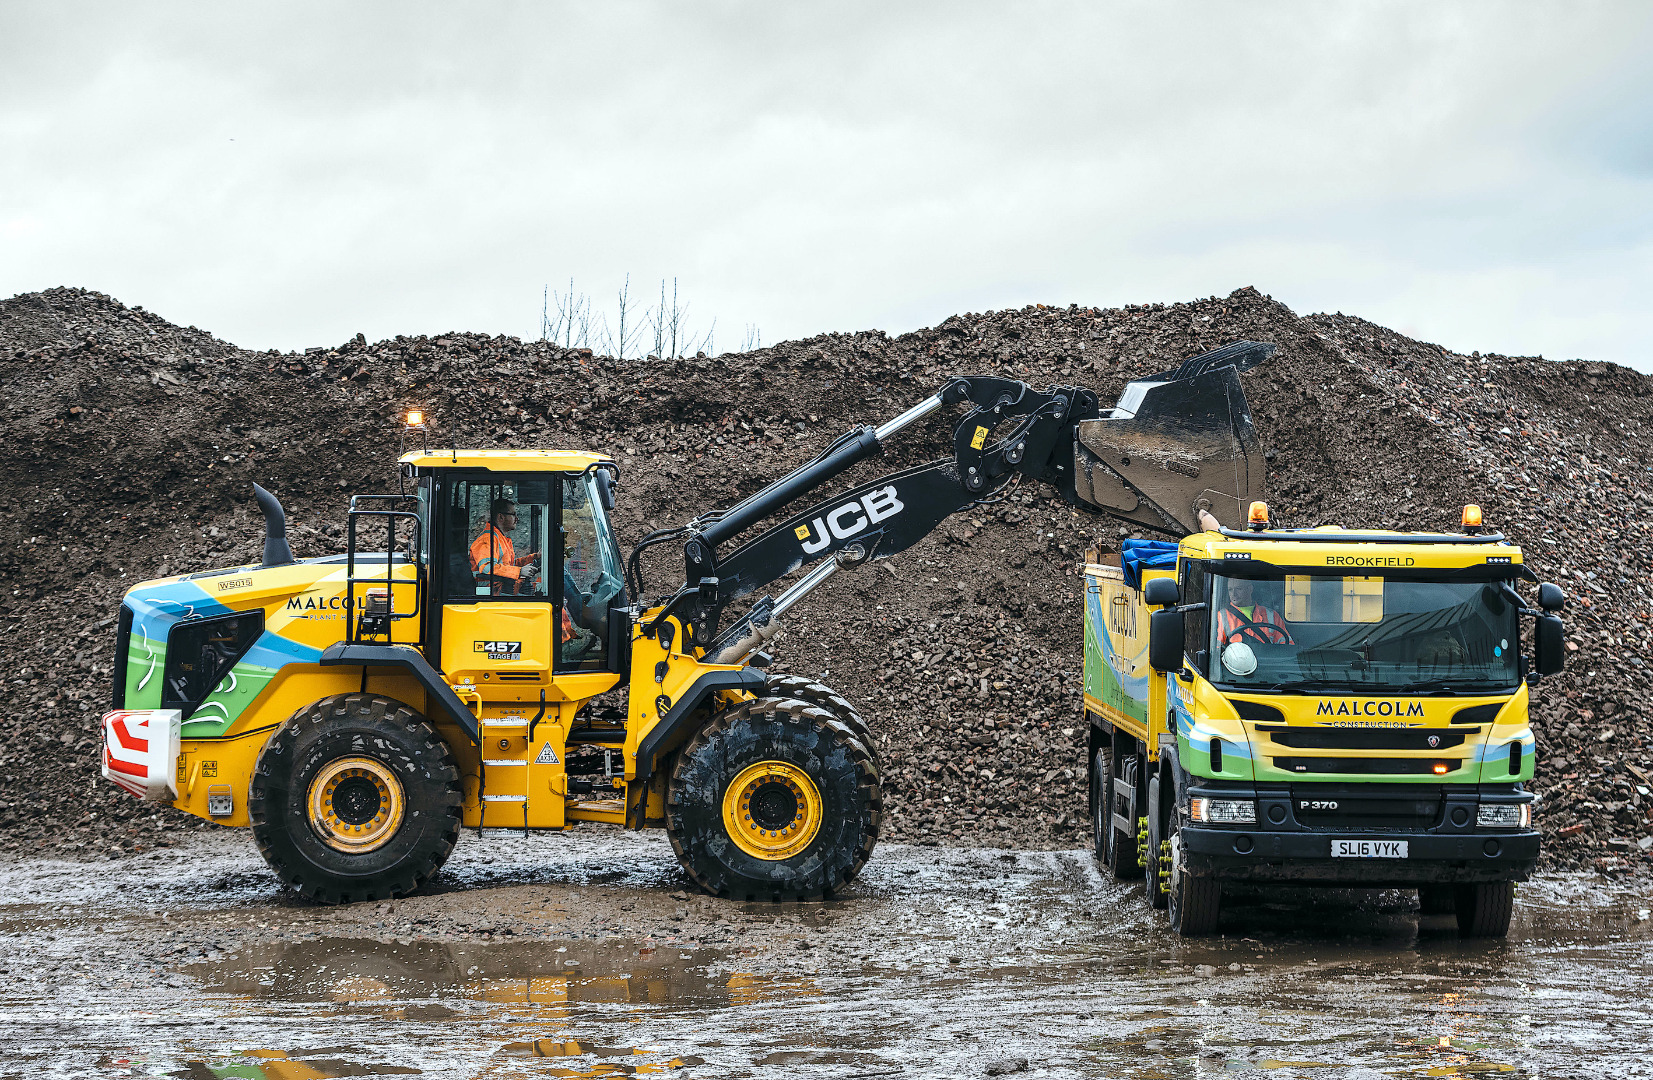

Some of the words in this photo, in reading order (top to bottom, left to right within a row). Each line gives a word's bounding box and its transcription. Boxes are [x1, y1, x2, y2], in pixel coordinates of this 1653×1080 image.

[801, 485, 904, 554] JCB
[1326, 556, 1415, 566] BROOKFIELD
[286, 596, 366, 610] MALCOL
[484, 641, 520, 652] 457
[1316, 700, 1425, 717] MALCOLM
[1333, 721, 1407, 729] CONSTRUCTION
[1300, 801, 1310, 810] P
[1311, 801, 1338, 810] 370
[1340, 842, 1370, 855] SL16
[1373, 842, 1400, 856] VYK
